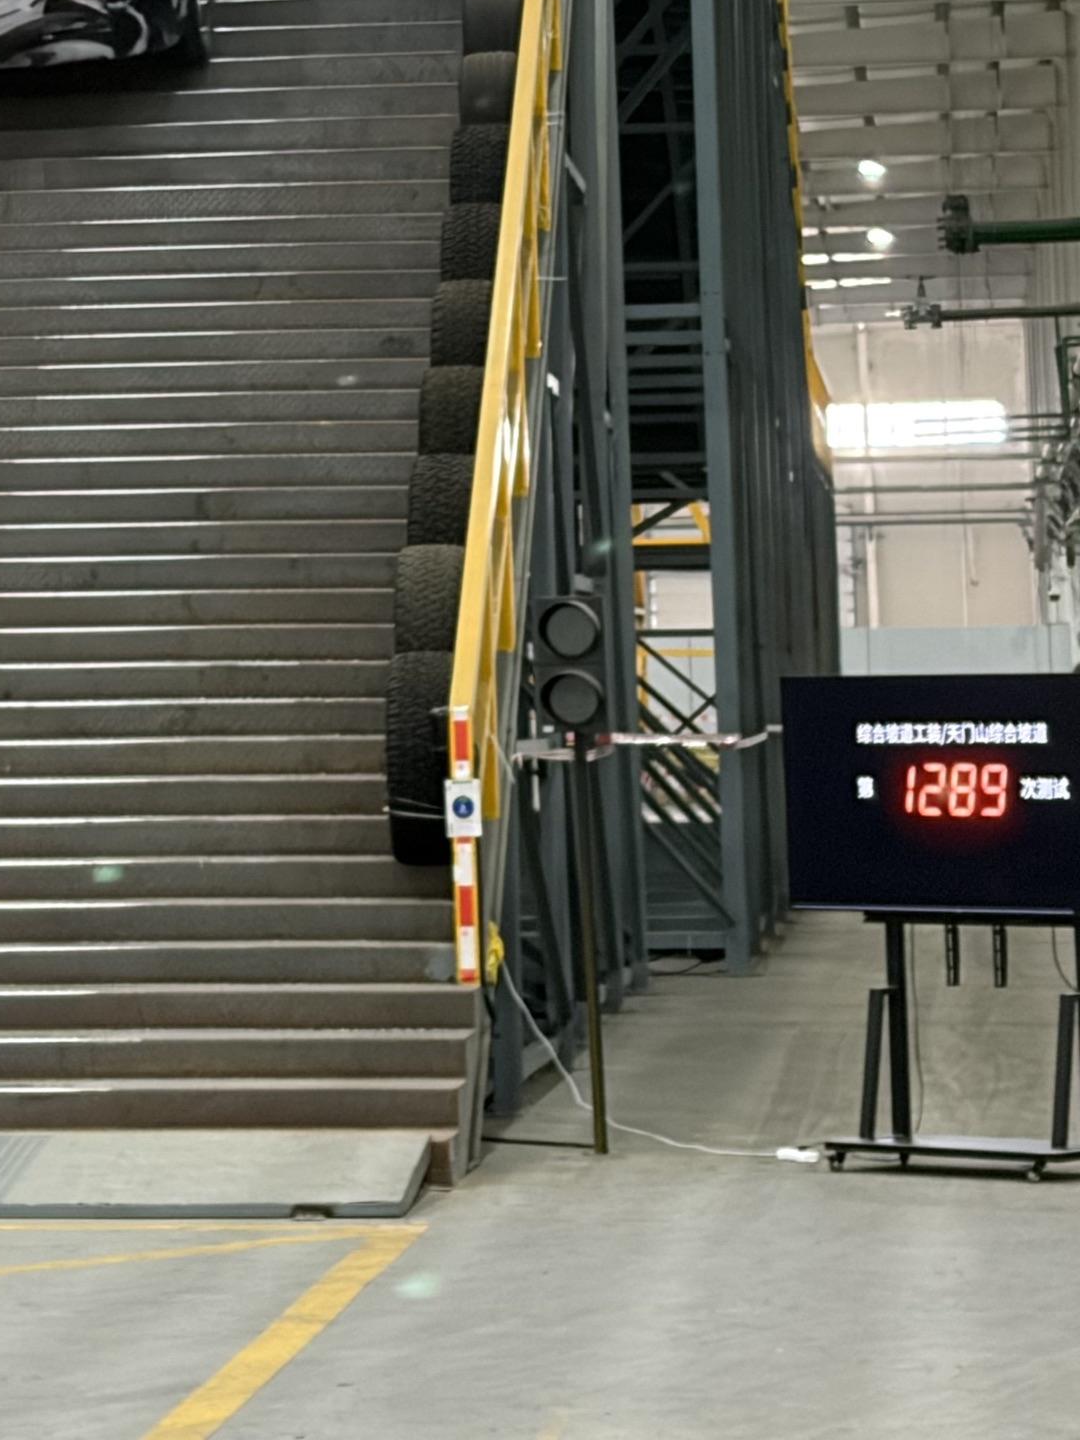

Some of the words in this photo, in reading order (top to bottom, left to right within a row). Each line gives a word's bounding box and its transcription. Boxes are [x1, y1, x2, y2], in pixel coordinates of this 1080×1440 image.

[904, 762, 1008, 817] 1289
[1019, 776, 1071, 800] 次测试
